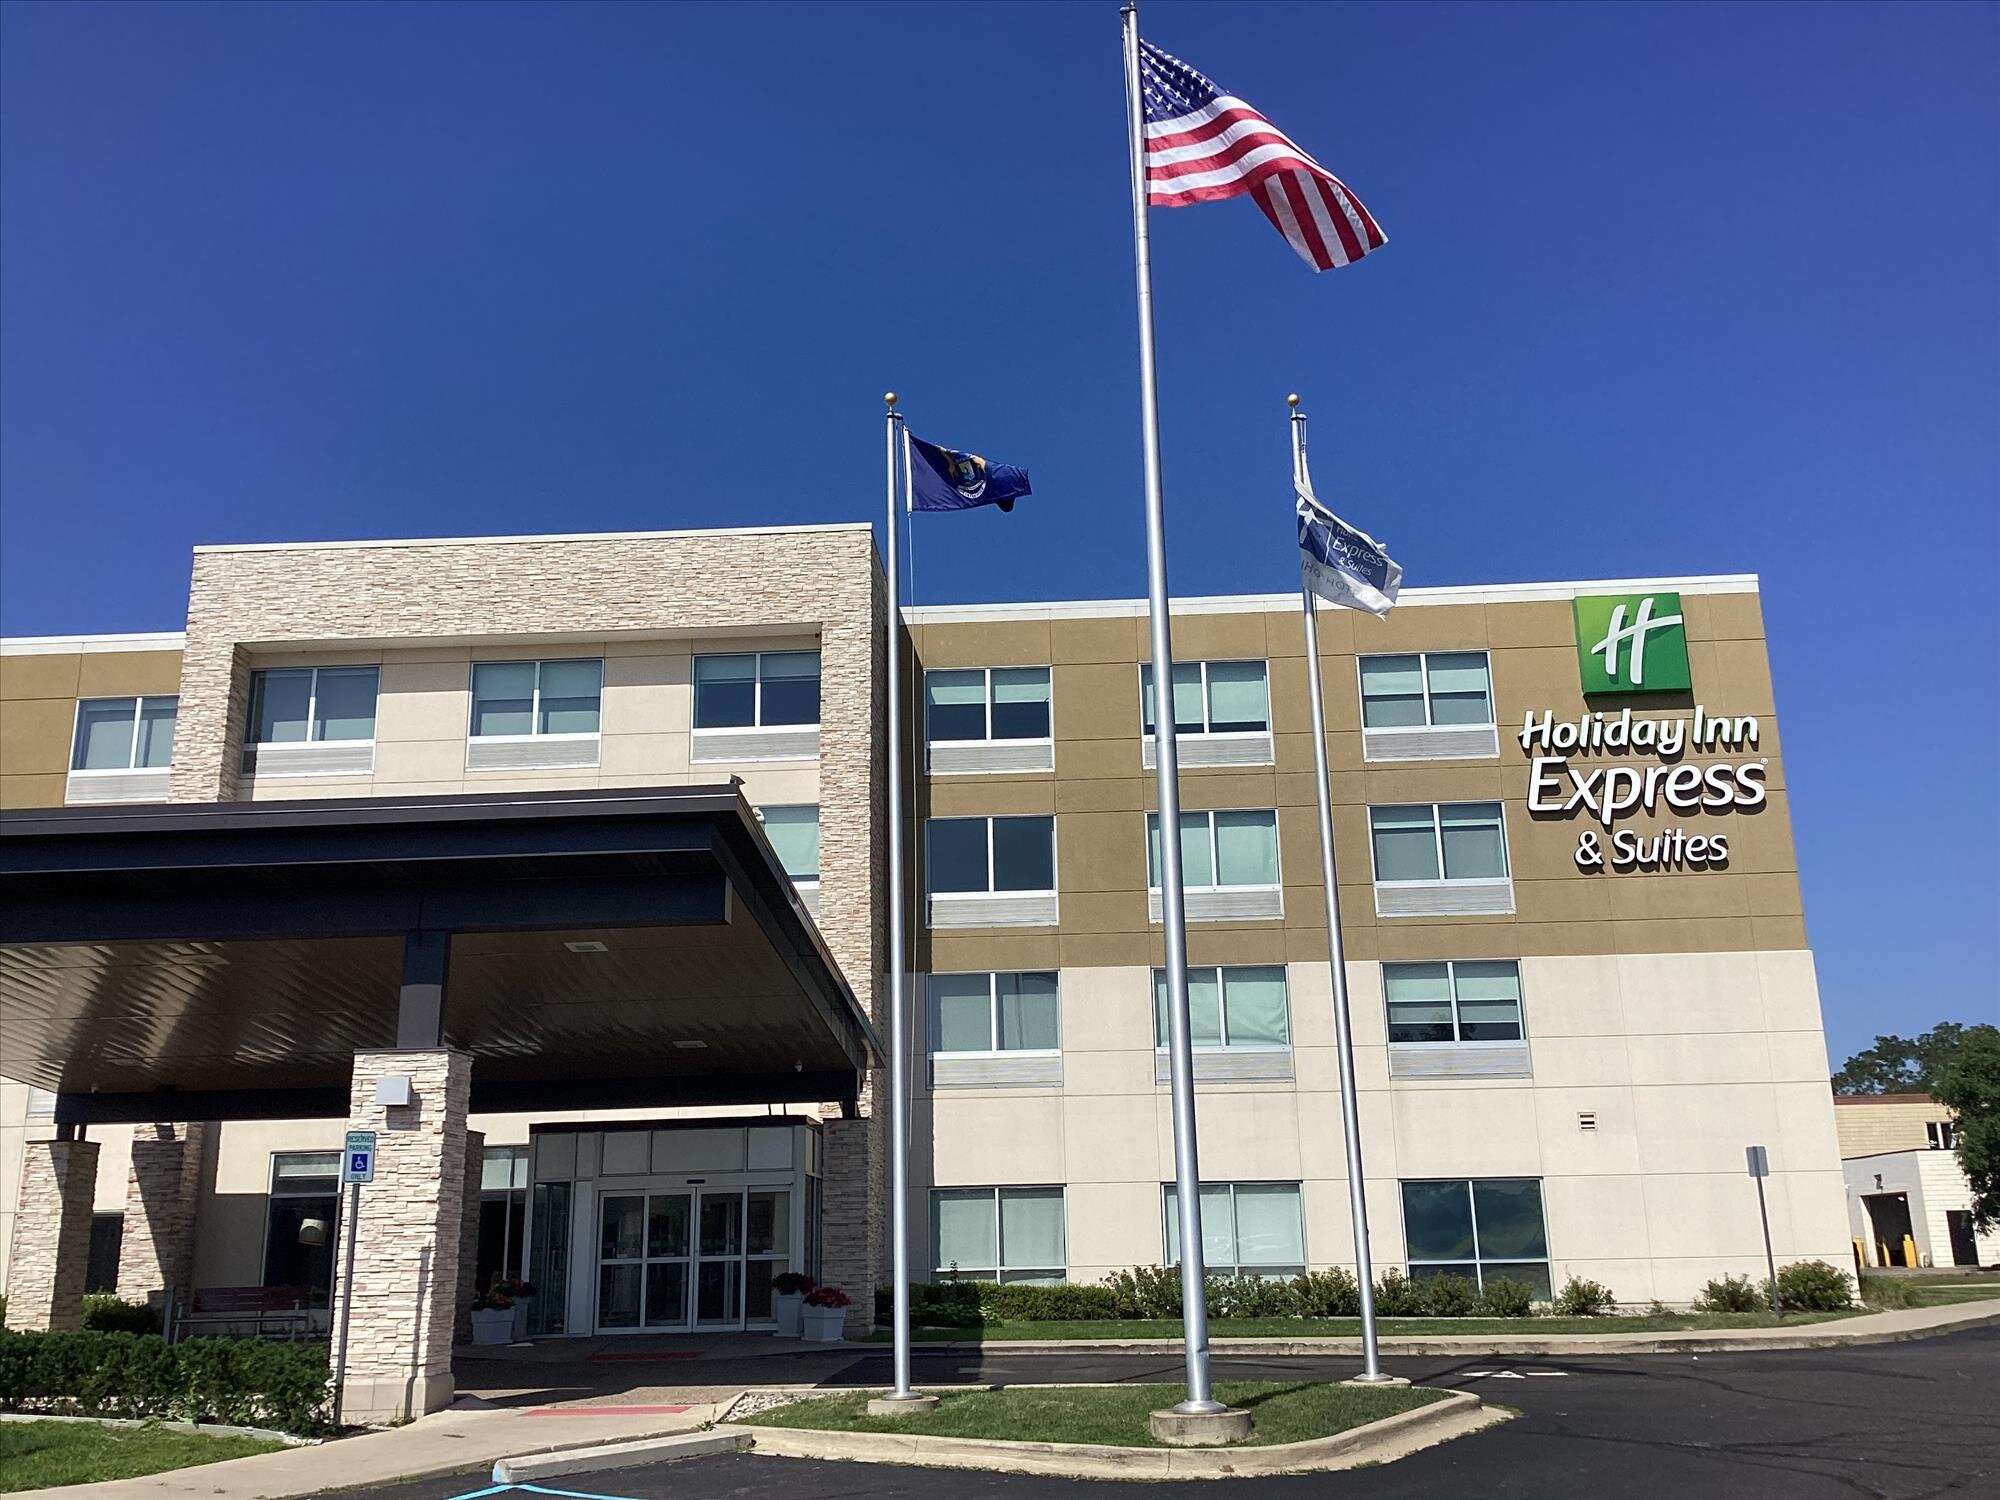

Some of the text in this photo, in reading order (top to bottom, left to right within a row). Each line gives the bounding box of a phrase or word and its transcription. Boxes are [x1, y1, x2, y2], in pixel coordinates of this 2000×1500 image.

[1332, 537, 1384, 567] Express
[1518, 704, 1758, 755] Holiday Inn
[1527, 755, 1766, 825] Express
[1574, 828, 1728, 865] & Suites
